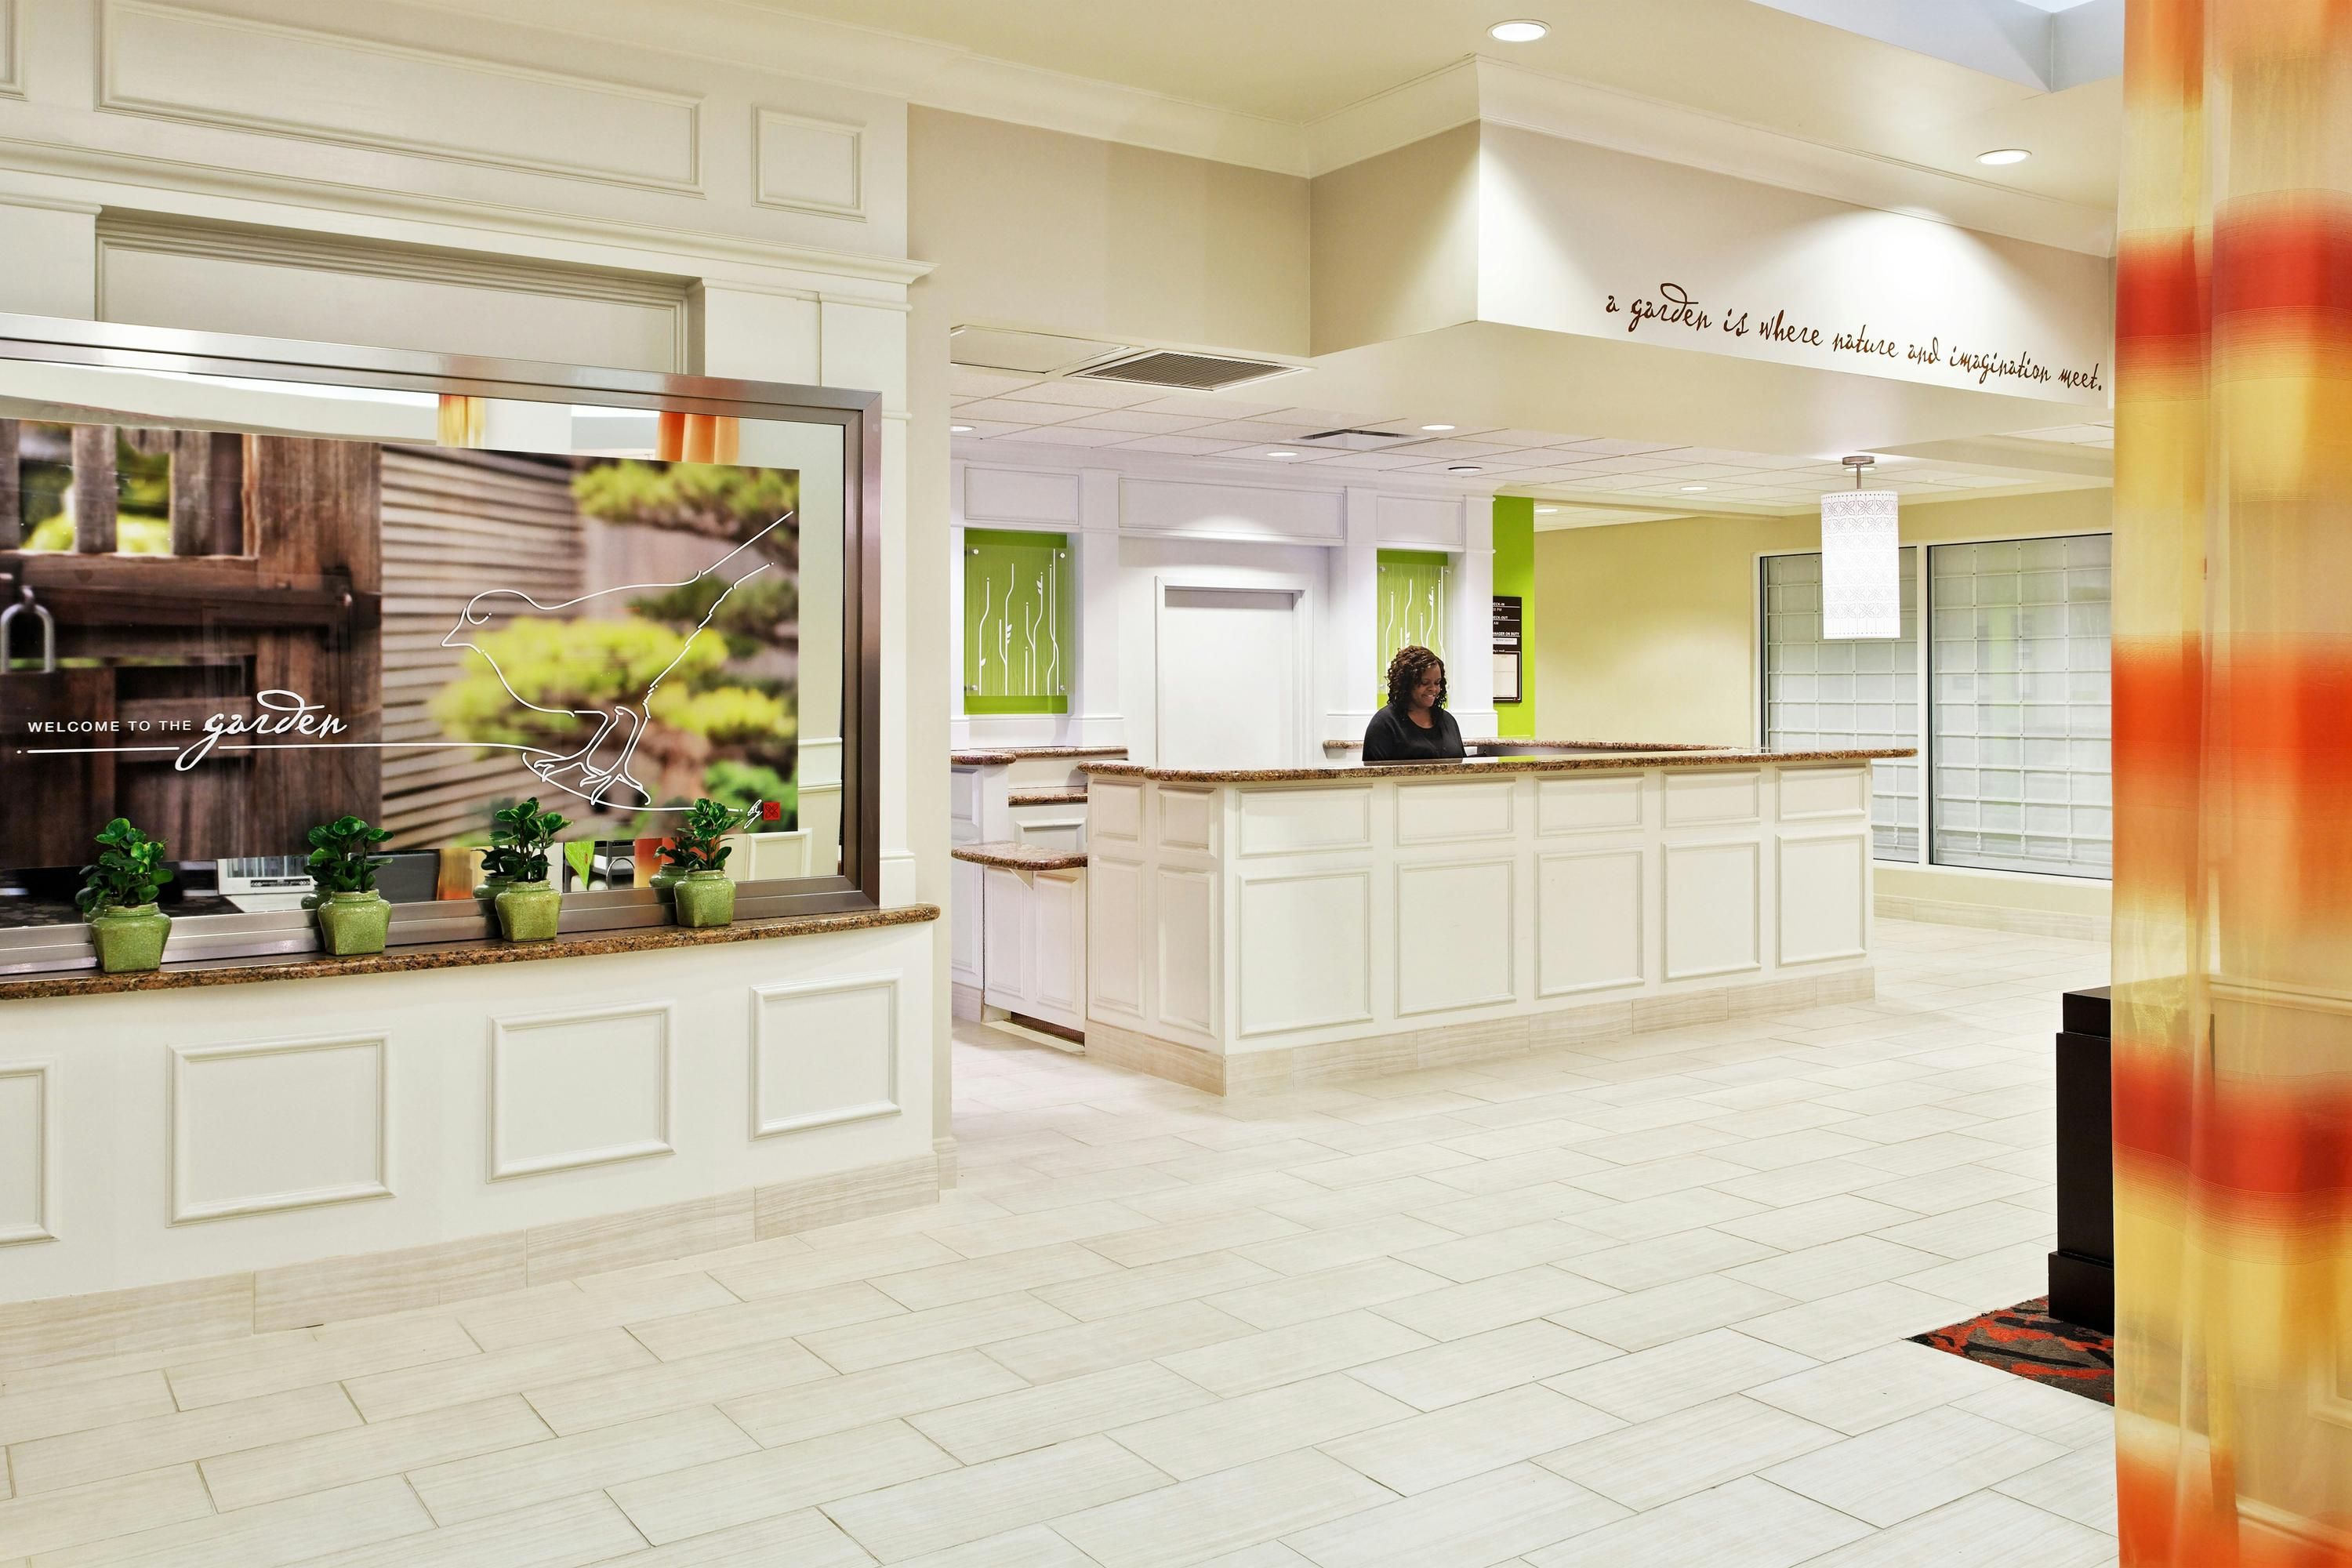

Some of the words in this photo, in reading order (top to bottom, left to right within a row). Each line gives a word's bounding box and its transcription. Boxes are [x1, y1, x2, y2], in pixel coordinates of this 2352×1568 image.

[1605, 295, 1621, 314] a
[1628, 282, 1712, 332] garden
[1723, 308, 1750, 337] is
[1759, 309, 1824, 346] where
[1832, 324, 1899, 358] nature
[1907, 337, 1941, 365] and
[1949, 346, 2052, 384] imagination
[2057, 362, 2102, 391] meet.
[27, 721, 119, 732] WELCOME
[128, 720, 151, 731] TO
[158, 720, 191, 731] THE
[175, 689, 347, 771] garden
